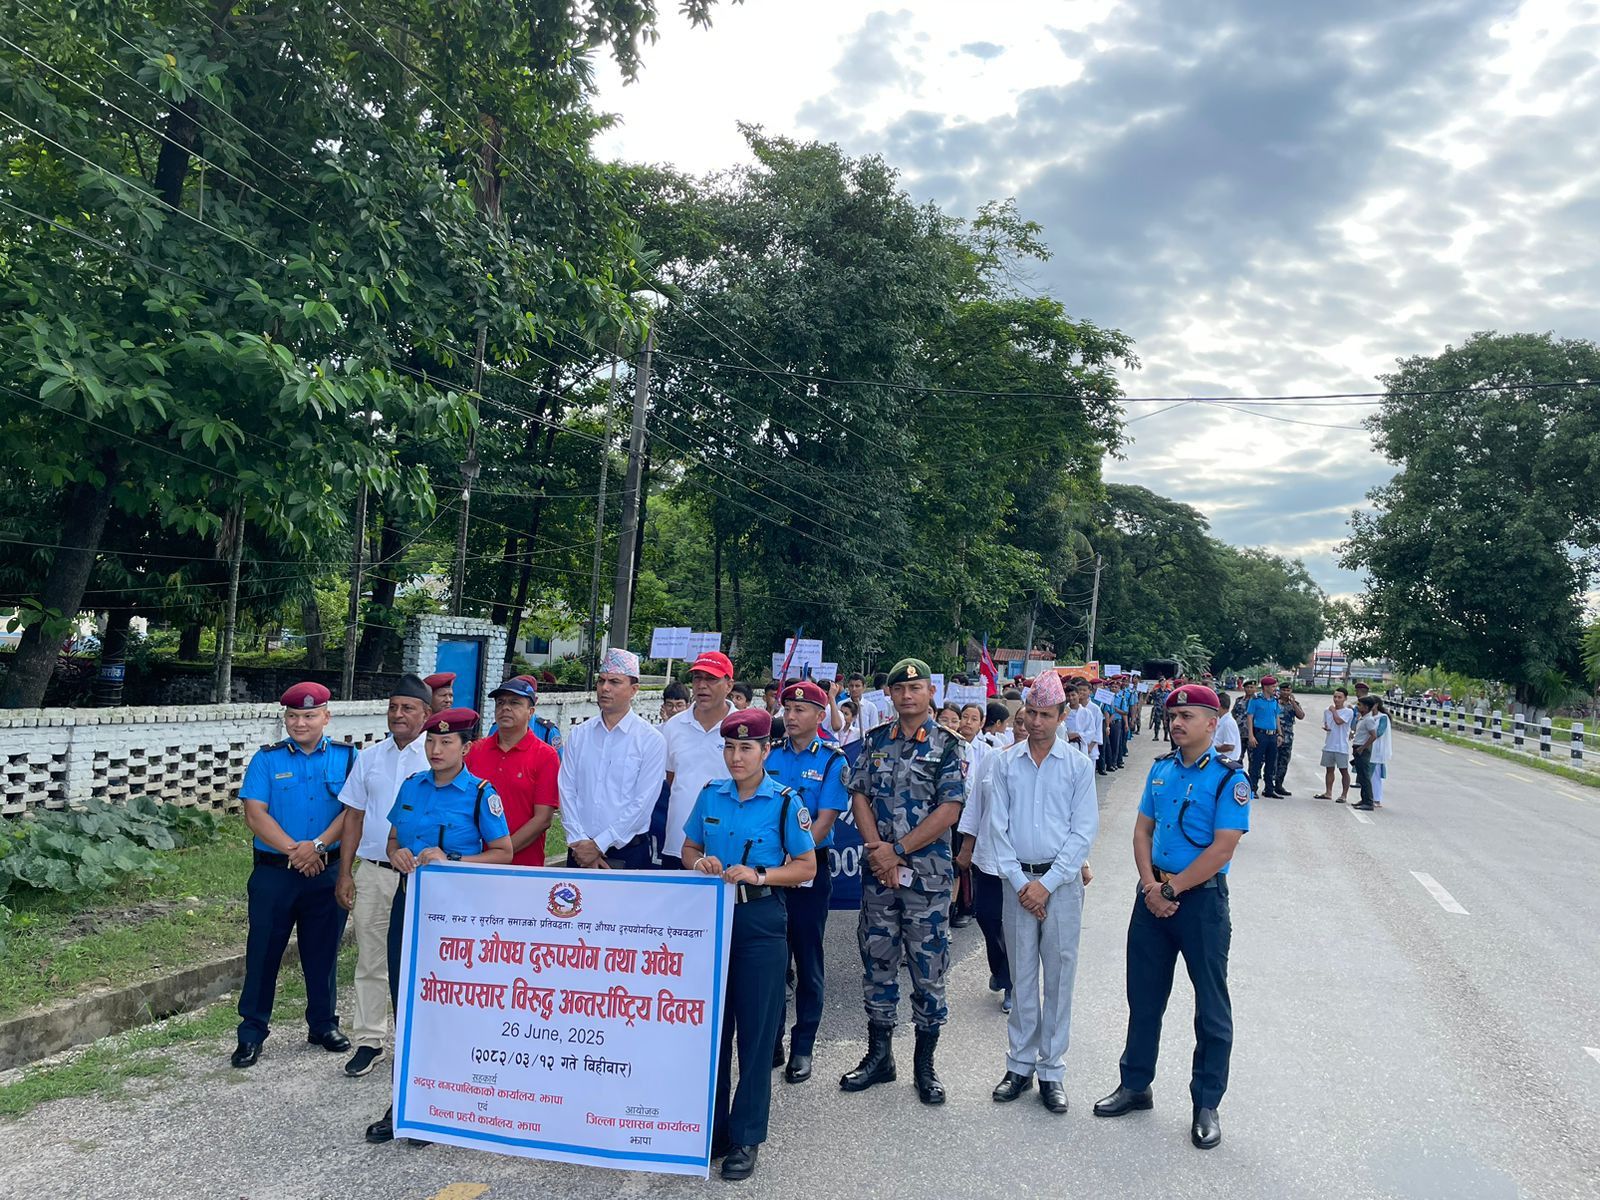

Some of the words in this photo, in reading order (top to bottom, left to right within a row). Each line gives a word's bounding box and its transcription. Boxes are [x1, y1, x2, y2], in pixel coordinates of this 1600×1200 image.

[471, 915, 477, 924] र
[480, 914, 505, 927] सुरक्षित
[508, 917, 537, 926] समाजको
[577, 921, 592, 933] लागु
[595, 920, 616, 932] औषध
[439, 936, 475, 969] लागु
[478, 931, 526, 964] औषध
[604, 947, 637, 973] तथा
[641, 942, 684, 976] अवैध
[420, 971, 508, 1010] ओसारपसार
[559, 985, 653, 1027] अन्तर्राष्ट्रिय
[656, 988, 705, 1026] दिवस
[501, 1021, 520, 1038] 26
[524, 1024, 562, 1044] June,
[568, 1027, 605, 1046] 2025
[561, 1054, 578, 1070] गते
[413, 1076, 436, 1089] भद्रपुर
[437, 1080, 495, 1097] नगरपालिकाको
[539, 1093, 564, 1105] झापा
[477, 1101, 488, 1112] एवं
[625, 1104, 660, 1118] आयोजक
[429, 1105, 454, 1119] जिल्ला
[456, 1111, 475, 1123] प्रहरी
[517, 1120, 541, 1132] झापा
[586, 1112, 615, 1126] जिल्ला
[619, 1118, 654, 1130] प्रशासन
[657, 1120, 700, 1132] कार्यालय
[630, 1136, 651, 1145] झापा
